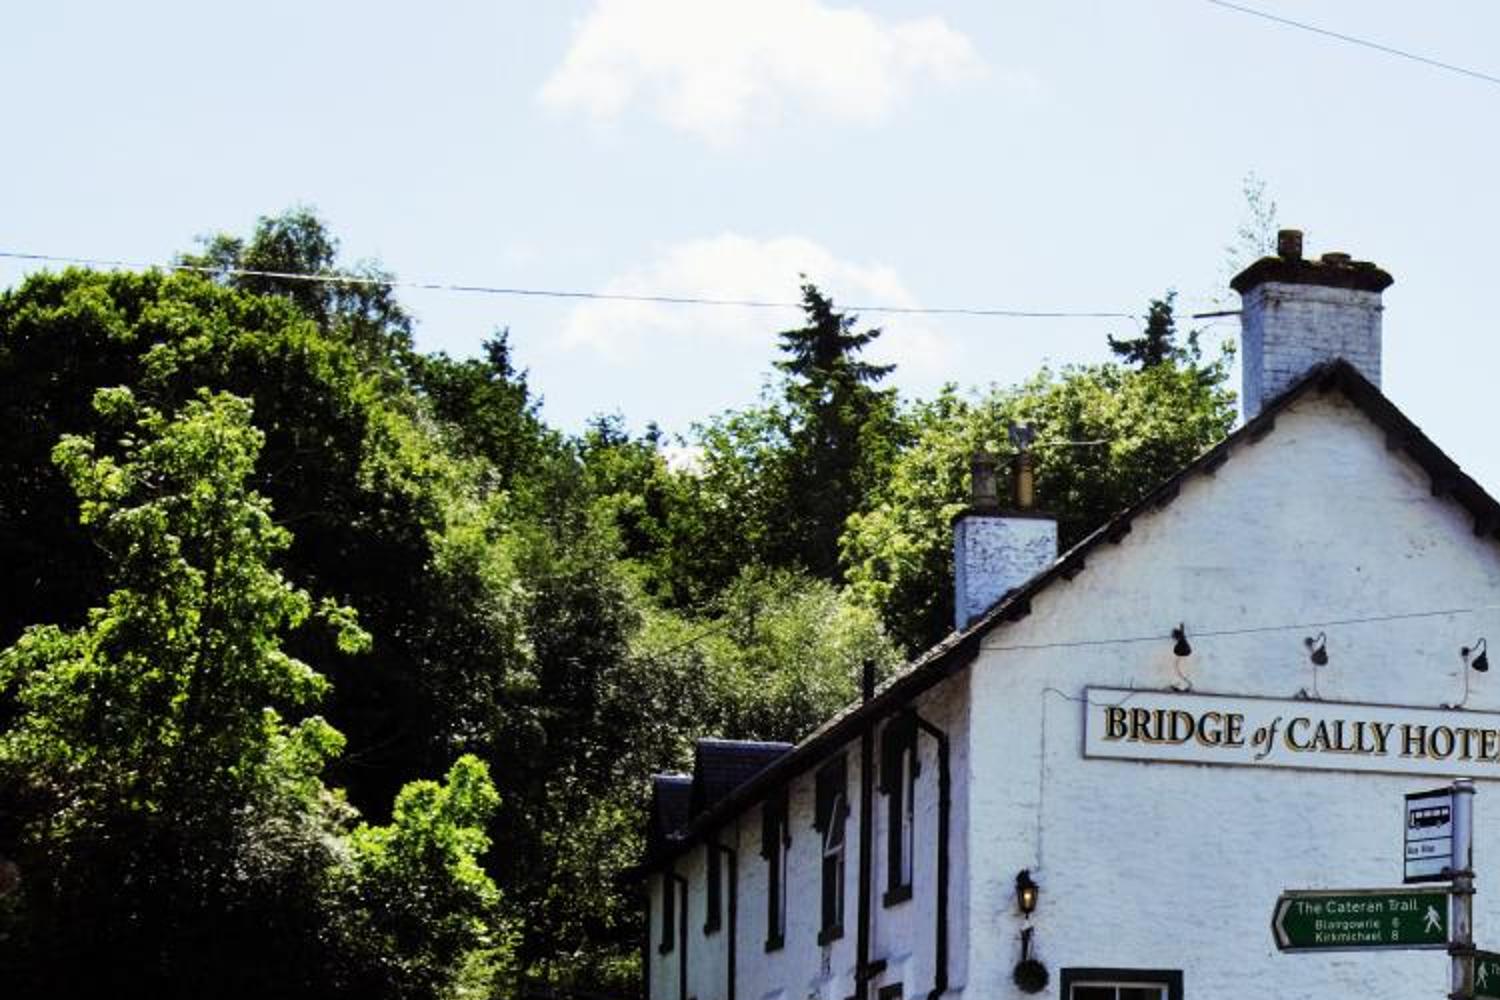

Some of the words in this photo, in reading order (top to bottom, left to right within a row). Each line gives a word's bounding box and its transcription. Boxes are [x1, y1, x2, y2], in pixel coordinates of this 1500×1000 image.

[1103, 706, 1245, 749] BRIDGE
[1252, 717, 1282, 760] of
[1285, 717, 1394, 756] CALLY
[1297, 900, 1322, 915] The
[1326, 900, 1383, 914] Cateran
[1388, 898, 1419, 912] Trail
[1391, 929, 1400, 941] 8
